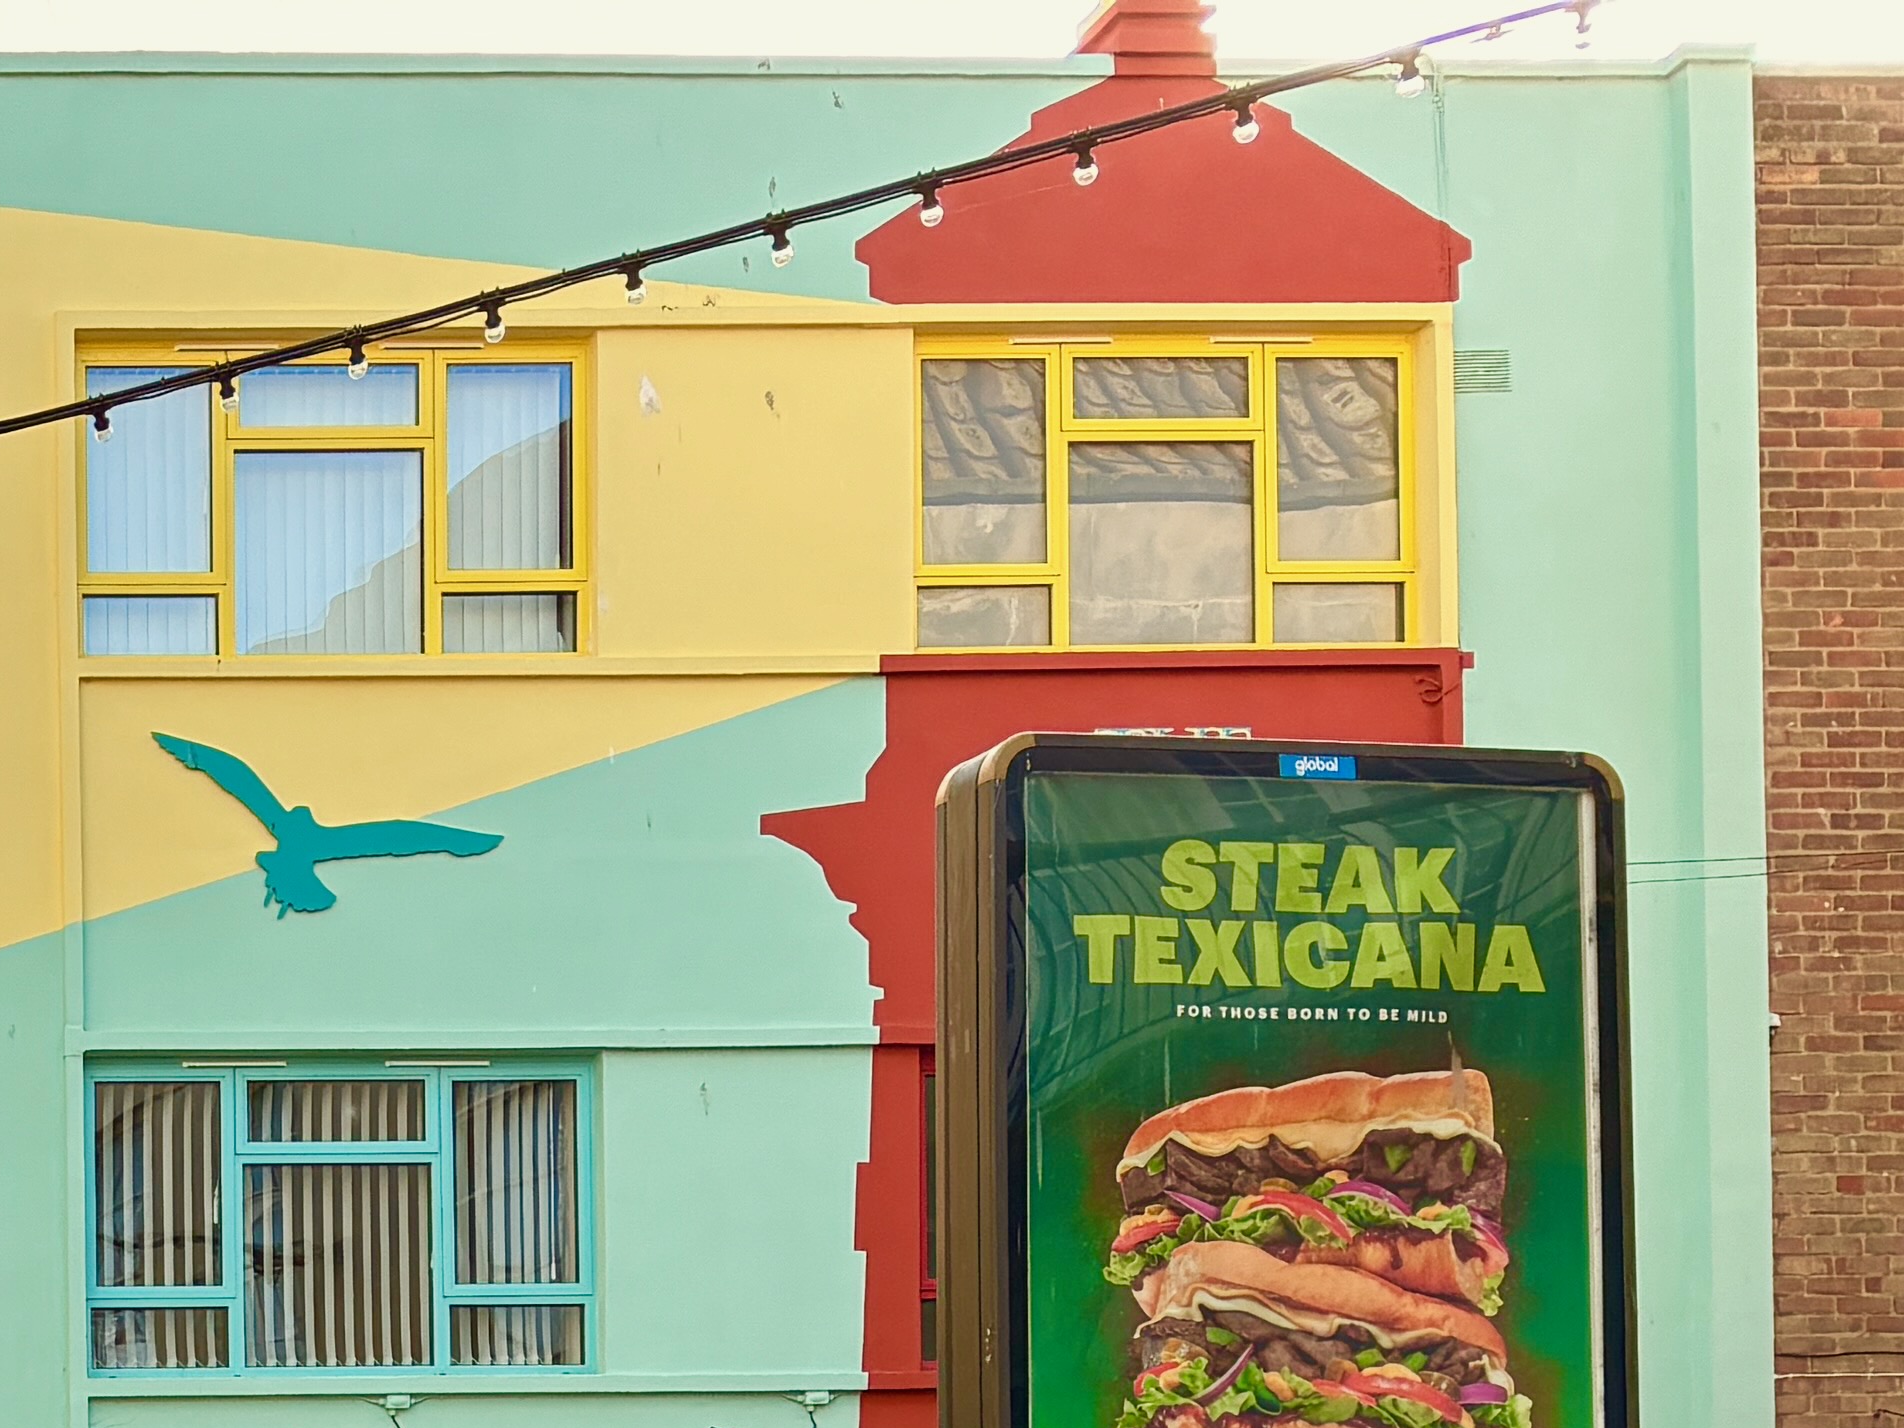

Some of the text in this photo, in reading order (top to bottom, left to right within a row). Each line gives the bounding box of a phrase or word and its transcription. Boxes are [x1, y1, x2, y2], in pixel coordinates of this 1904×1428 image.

[1294, 755, 1340, 776] global
[1160, 838, 1461, 916] STEAK
[1074, 913, 1547, 995] TEXICANA
[1176, 1004, 1448, 1024] FOR THOSE BORN TO BE MILD
